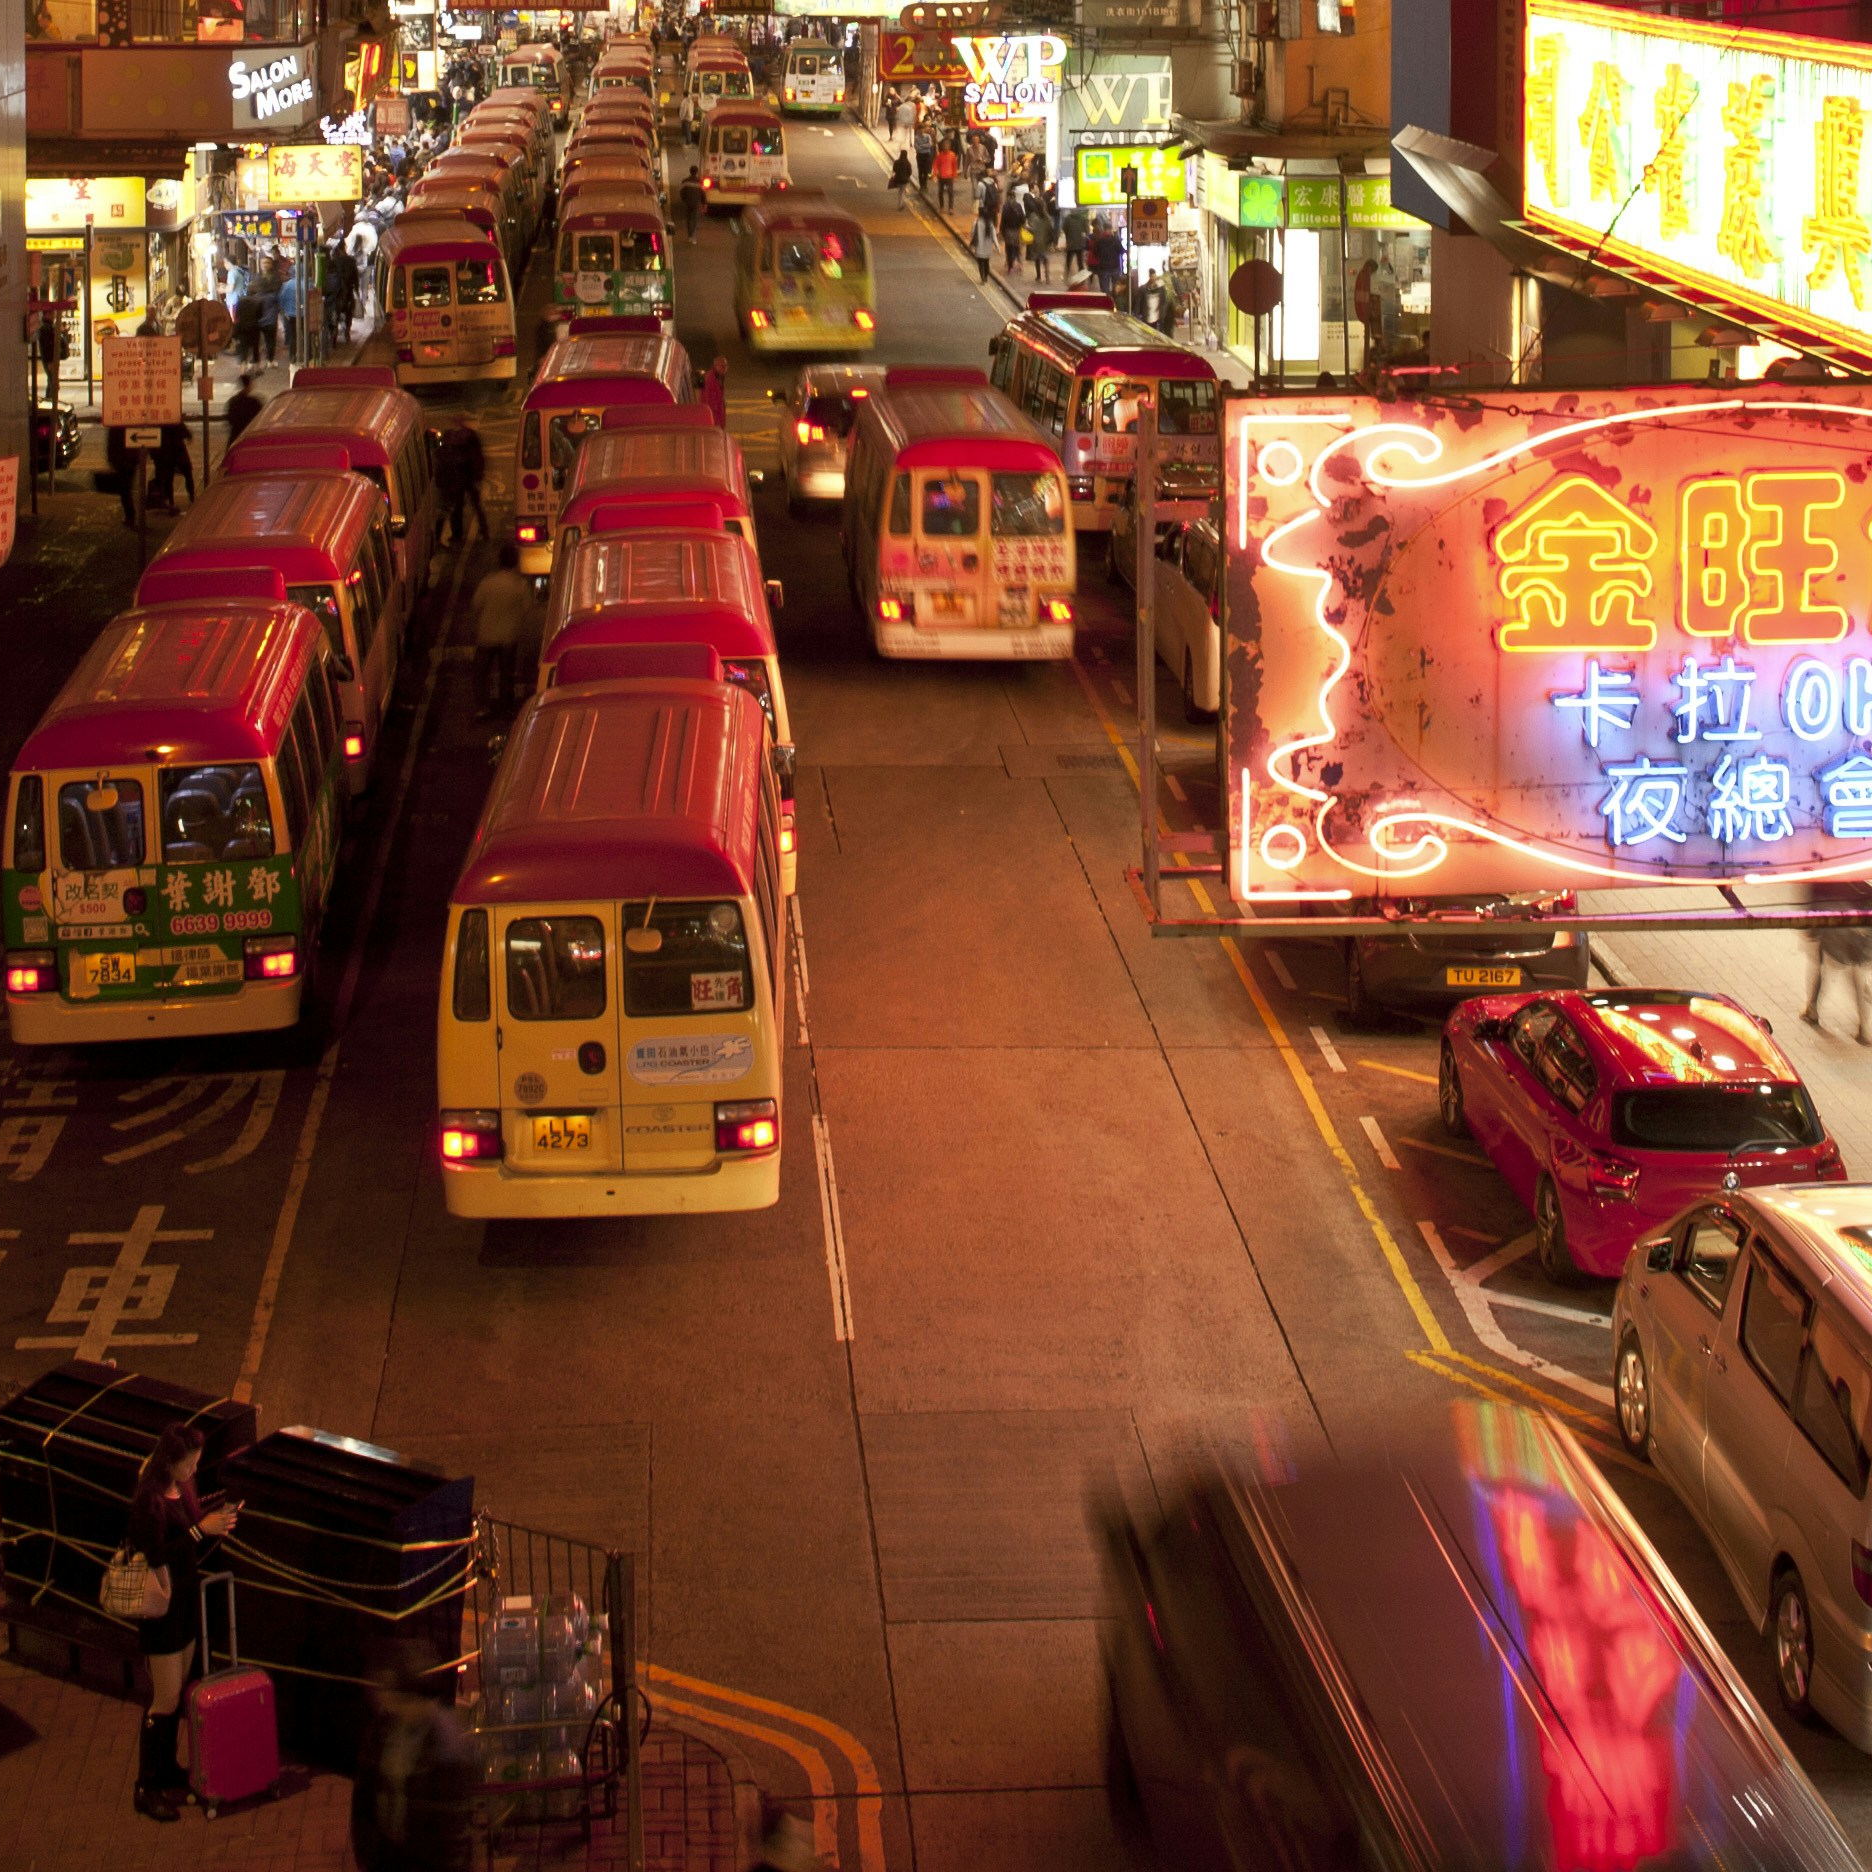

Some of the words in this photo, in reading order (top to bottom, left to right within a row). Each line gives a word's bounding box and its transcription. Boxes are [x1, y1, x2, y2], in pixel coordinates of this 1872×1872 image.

[951, 35, 1067, 84] WP
[229, 55, 297, 99] SALON
[256, 78, 313, 120] MORE
[964, 82, 1054, 103] SALON
[111, 350, 143, 359] waiting
[107, 369, 140, 378] without
[144, 368, 177, 378] warning
[79, 903, 106, 914] $500
[171, 913, 220, 935] 6639
[223, 908, 272, 931] 9999
[100, 958, 120, 970] SW
[89, 969, 132, 983] 7834
[1453, 968, 1474, 985] TU
[1477, 968, 1516, 985] 2167
[636, 1061, 657, 1069] LPG
[660, 1059, 711, 1068] COASTER
[549, 1119, 575, 1136] LL
[625, 1124, 711, 1134] COASTER
[537, 1133, 589, 1149] 4273
